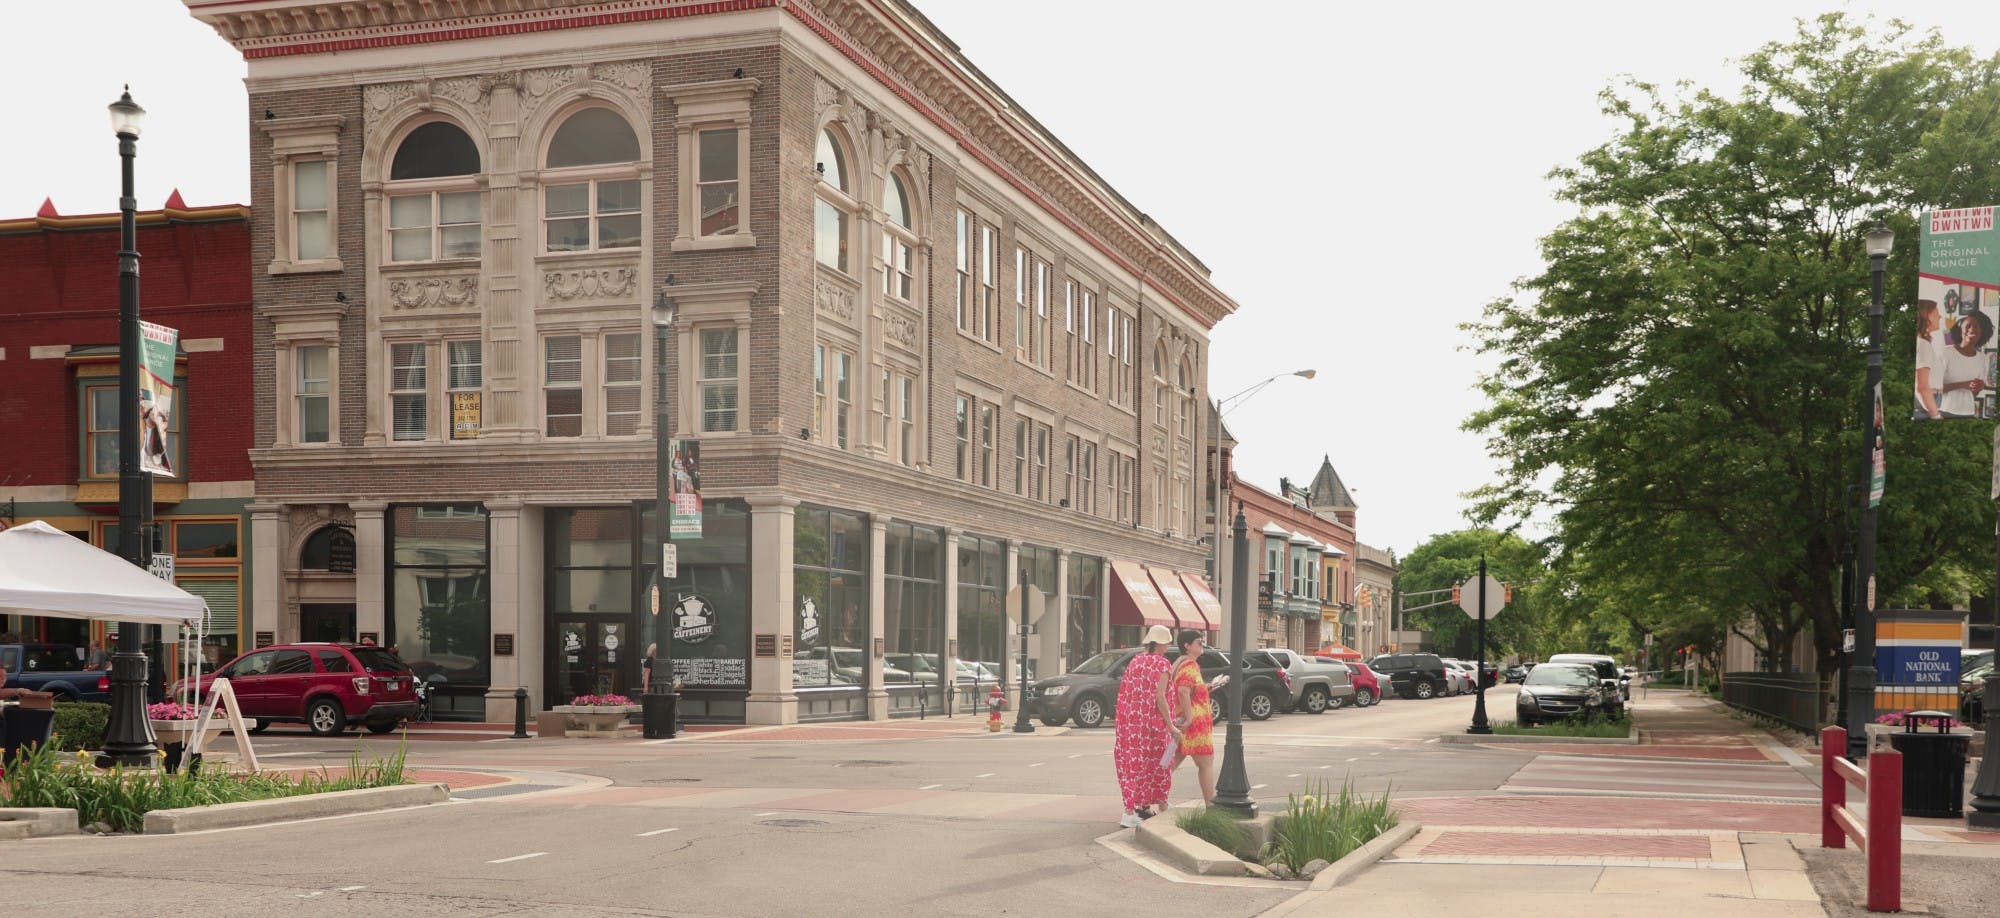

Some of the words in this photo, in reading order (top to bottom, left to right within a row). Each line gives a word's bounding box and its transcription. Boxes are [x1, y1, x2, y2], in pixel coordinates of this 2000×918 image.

[1932, 217, 1992, 232] DWNTWN
[1931, 239, 1953, 248] THE
[1931, 246, 1990, 258] ORIGINAL
[1930, 258, 1977, 269] MUNCIE
[458, 393, 474, 401] FOR
[454, 403, 480, 411] LEASE
[151, 557, 171, 569] ONE
[152, 569, 171, 581] WAY
[674, 625, 712, 639] CAFFEINERY
[1919, 651, 1940, 661] OLD
[1905, 661, 1952, 671] NATIONAL
[1916, 672, 1942, 682] BANK
